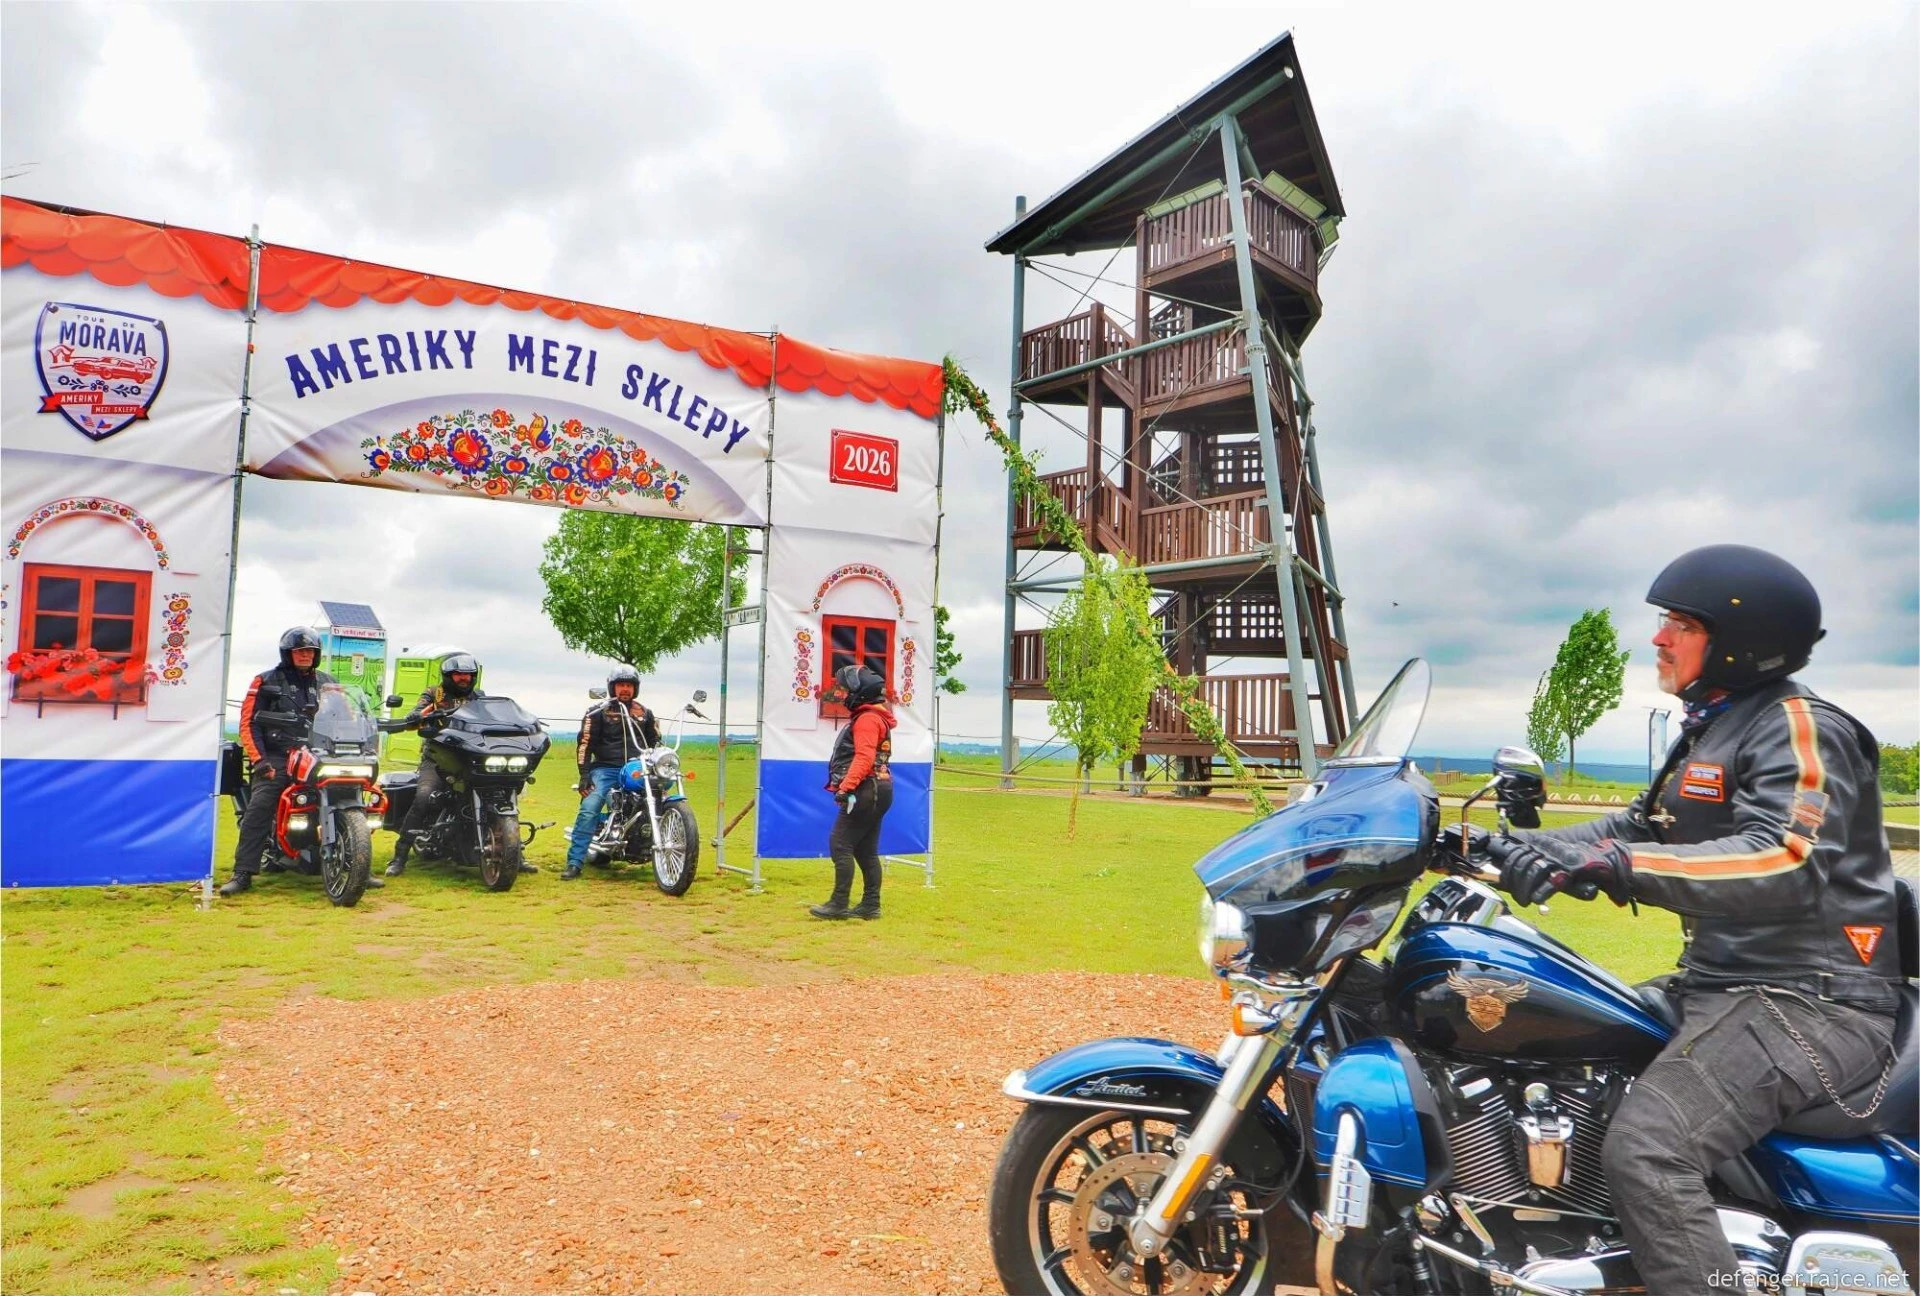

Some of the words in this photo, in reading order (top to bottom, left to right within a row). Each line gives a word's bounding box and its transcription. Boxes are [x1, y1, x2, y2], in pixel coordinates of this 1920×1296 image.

[76, 314, 105, 323] TOUR
[60, 320, 147, 357] MORAVA
[60, 393, 100, 404] AMERIKY
[284, 329, 477, 399] AMERIKY
[508, 333, 597, 387] MEZI
[621, 364, 751, 454] SKLEPY
[842, 444, 891, 477] 2026
[1075, 1076, 1147, 1097] Limited
